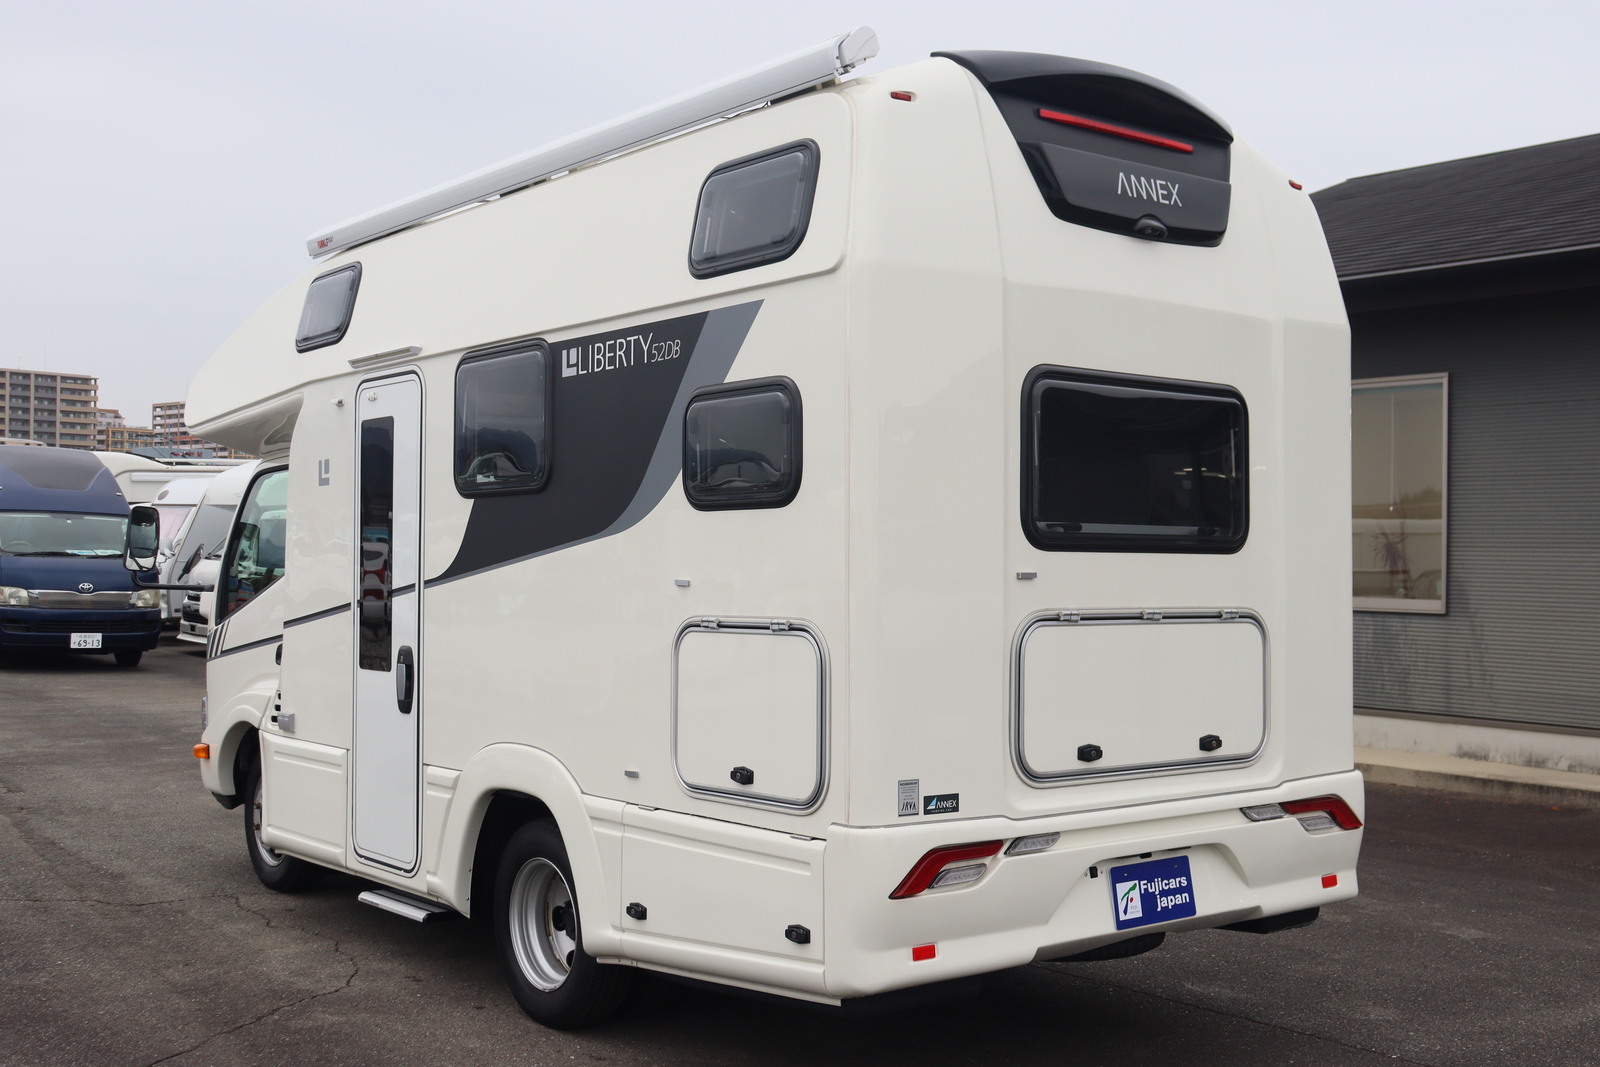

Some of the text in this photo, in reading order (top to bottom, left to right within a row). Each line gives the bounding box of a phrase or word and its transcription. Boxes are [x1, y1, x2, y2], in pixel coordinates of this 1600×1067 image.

[1117, 171, 1183, 208] ANNEX
[578, 332, 681, 375] LIBERTY 52DB
[936, 800, 957, 809] ANNEX
[1140, 876, 1188, 895] Fujicars
[1156, 892, 1190, 911] japan
